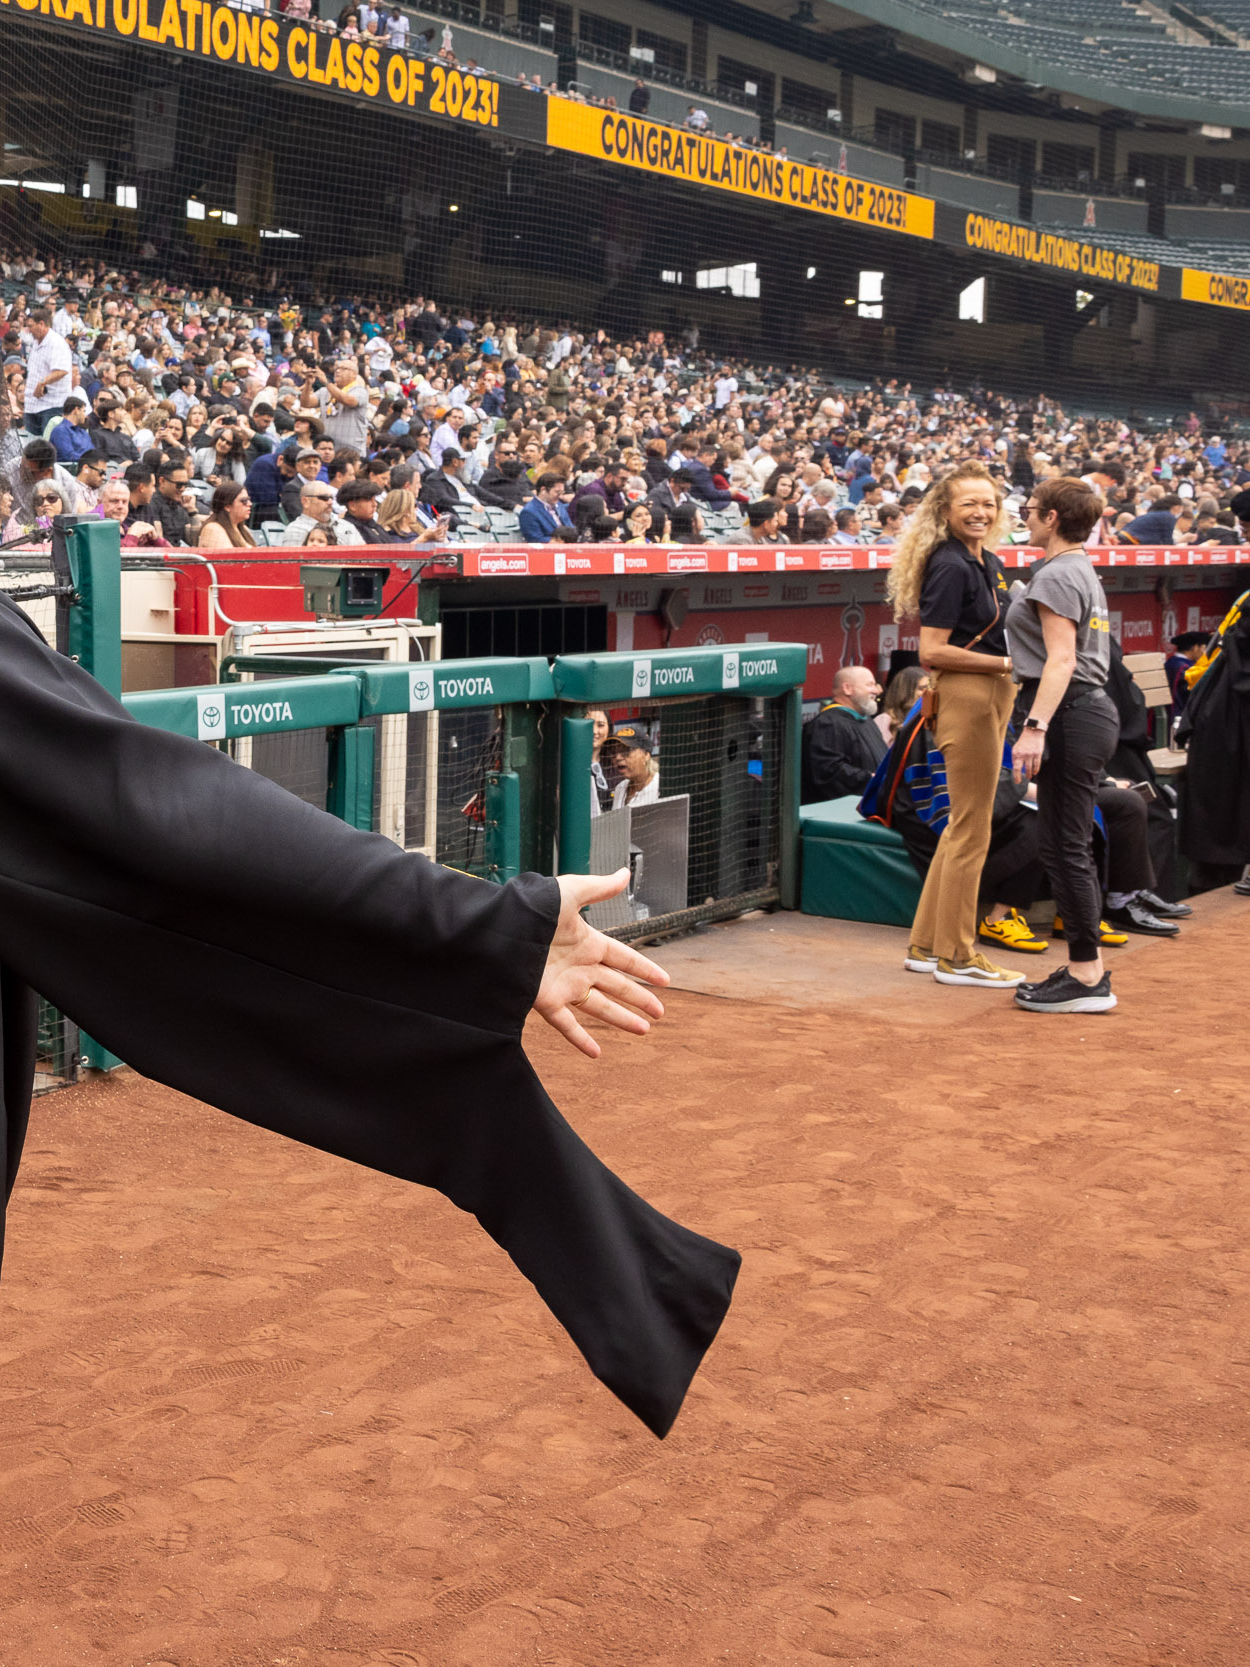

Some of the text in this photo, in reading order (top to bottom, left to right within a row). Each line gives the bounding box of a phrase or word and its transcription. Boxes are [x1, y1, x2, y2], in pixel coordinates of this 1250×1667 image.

[287, 27, 380, 97] CLASS
[386, 54, 425, 106] OF
[429, 66, 500, 127] 2023!
[601, 114, 907, 228] CONGRATULATIONS CLASS OF 2023!
[965, 213, 1160, 291] CONGRATULATIONS CLASS OF 2023!
[481, 557, 526, 572] angels.com
[566, 558, 592, 569] TOYOTA
[625, 558, 648, 568] TOYOTA
[669, 556, 706, 570] angels.com
[654, 667, 694, 686] TOYOTA
[742, 659, 778, 677] TOYOTA
[438, 677, 494, 698] TOYOTA
[231, 702, 293, 725] TOYOTA
